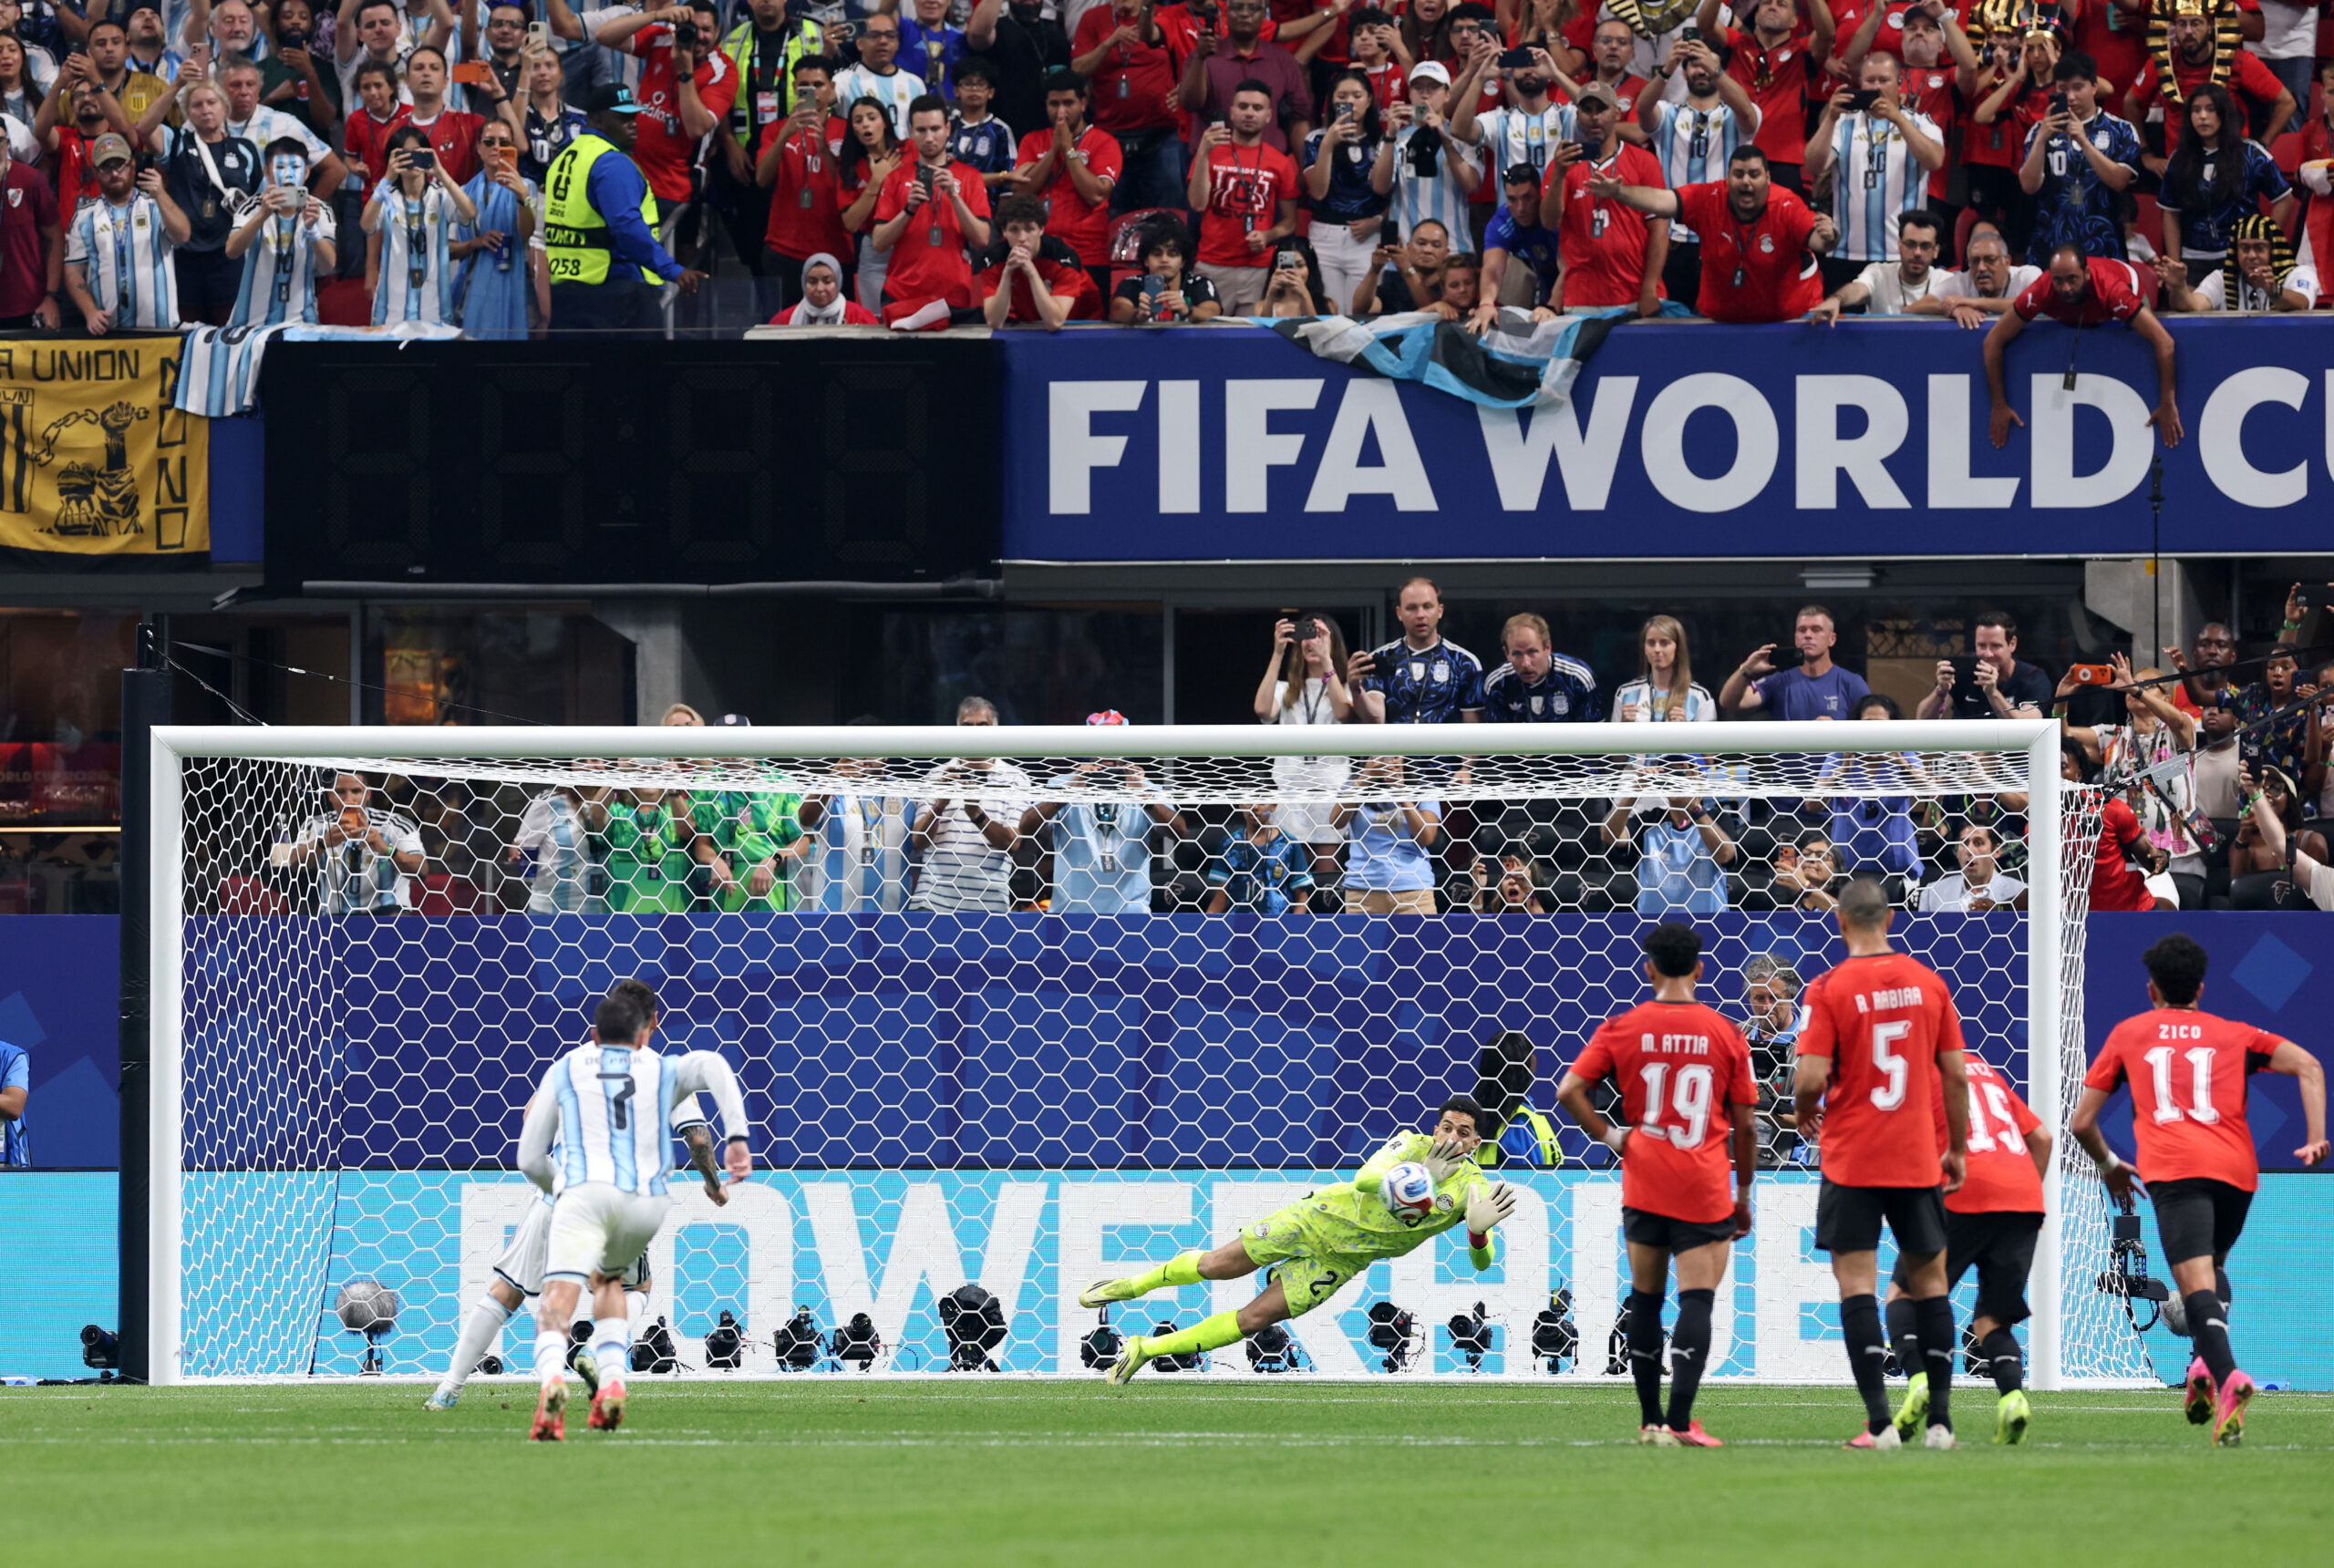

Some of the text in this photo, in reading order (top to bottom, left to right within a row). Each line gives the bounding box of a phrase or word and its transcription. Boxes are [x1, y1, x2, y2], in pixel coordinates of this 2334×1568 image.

[2047, 150, 2067, 176] 10
[32, 349, 139, 382] UNION
[1049, 366, 2334, 514] FIFA WORLD C
[1246, 880, 1265, 902] 10
[1641, 1033, 1709, 1056] M. ATTIA
[2158, 1023, 2202, 1039] ZICO
[1870, 1019, 1913, 1111] 5
[2143, 1046, 2220, 1126] 11
[595, 1073, 636, 1130] 7
[1639, 1061, 1715, 1151] 19
[1967, 1081, 2028, 1156] 15
